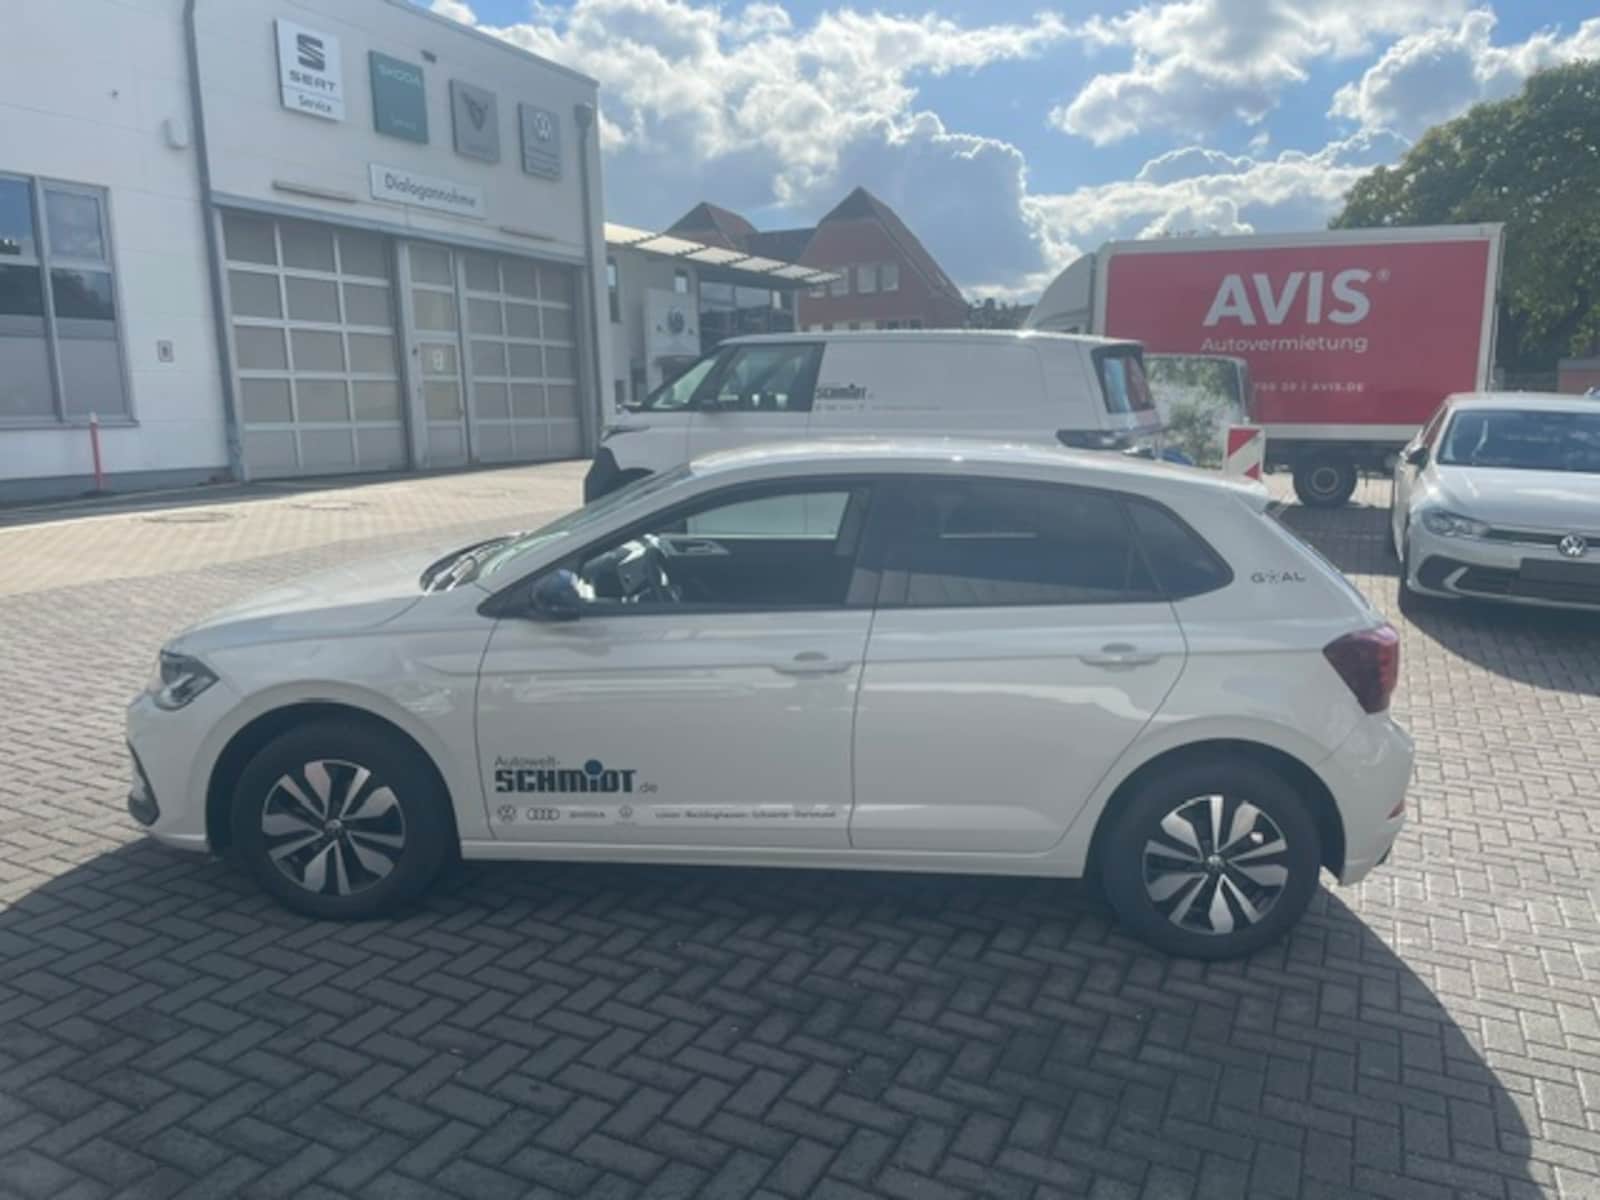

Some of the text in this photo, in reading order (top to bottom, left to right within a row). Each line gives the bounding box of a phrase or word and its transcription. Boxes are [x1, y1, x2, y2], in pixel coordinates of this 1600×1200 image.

[289, 70, 337, 92] SEAT
[298, 94, 332, 113] Service
[384, 172, 476, 208] Dialogannahme
[1202, 268, 1373, 327] AVIS
[1200, 335, 1369, 353] Autovermietung
